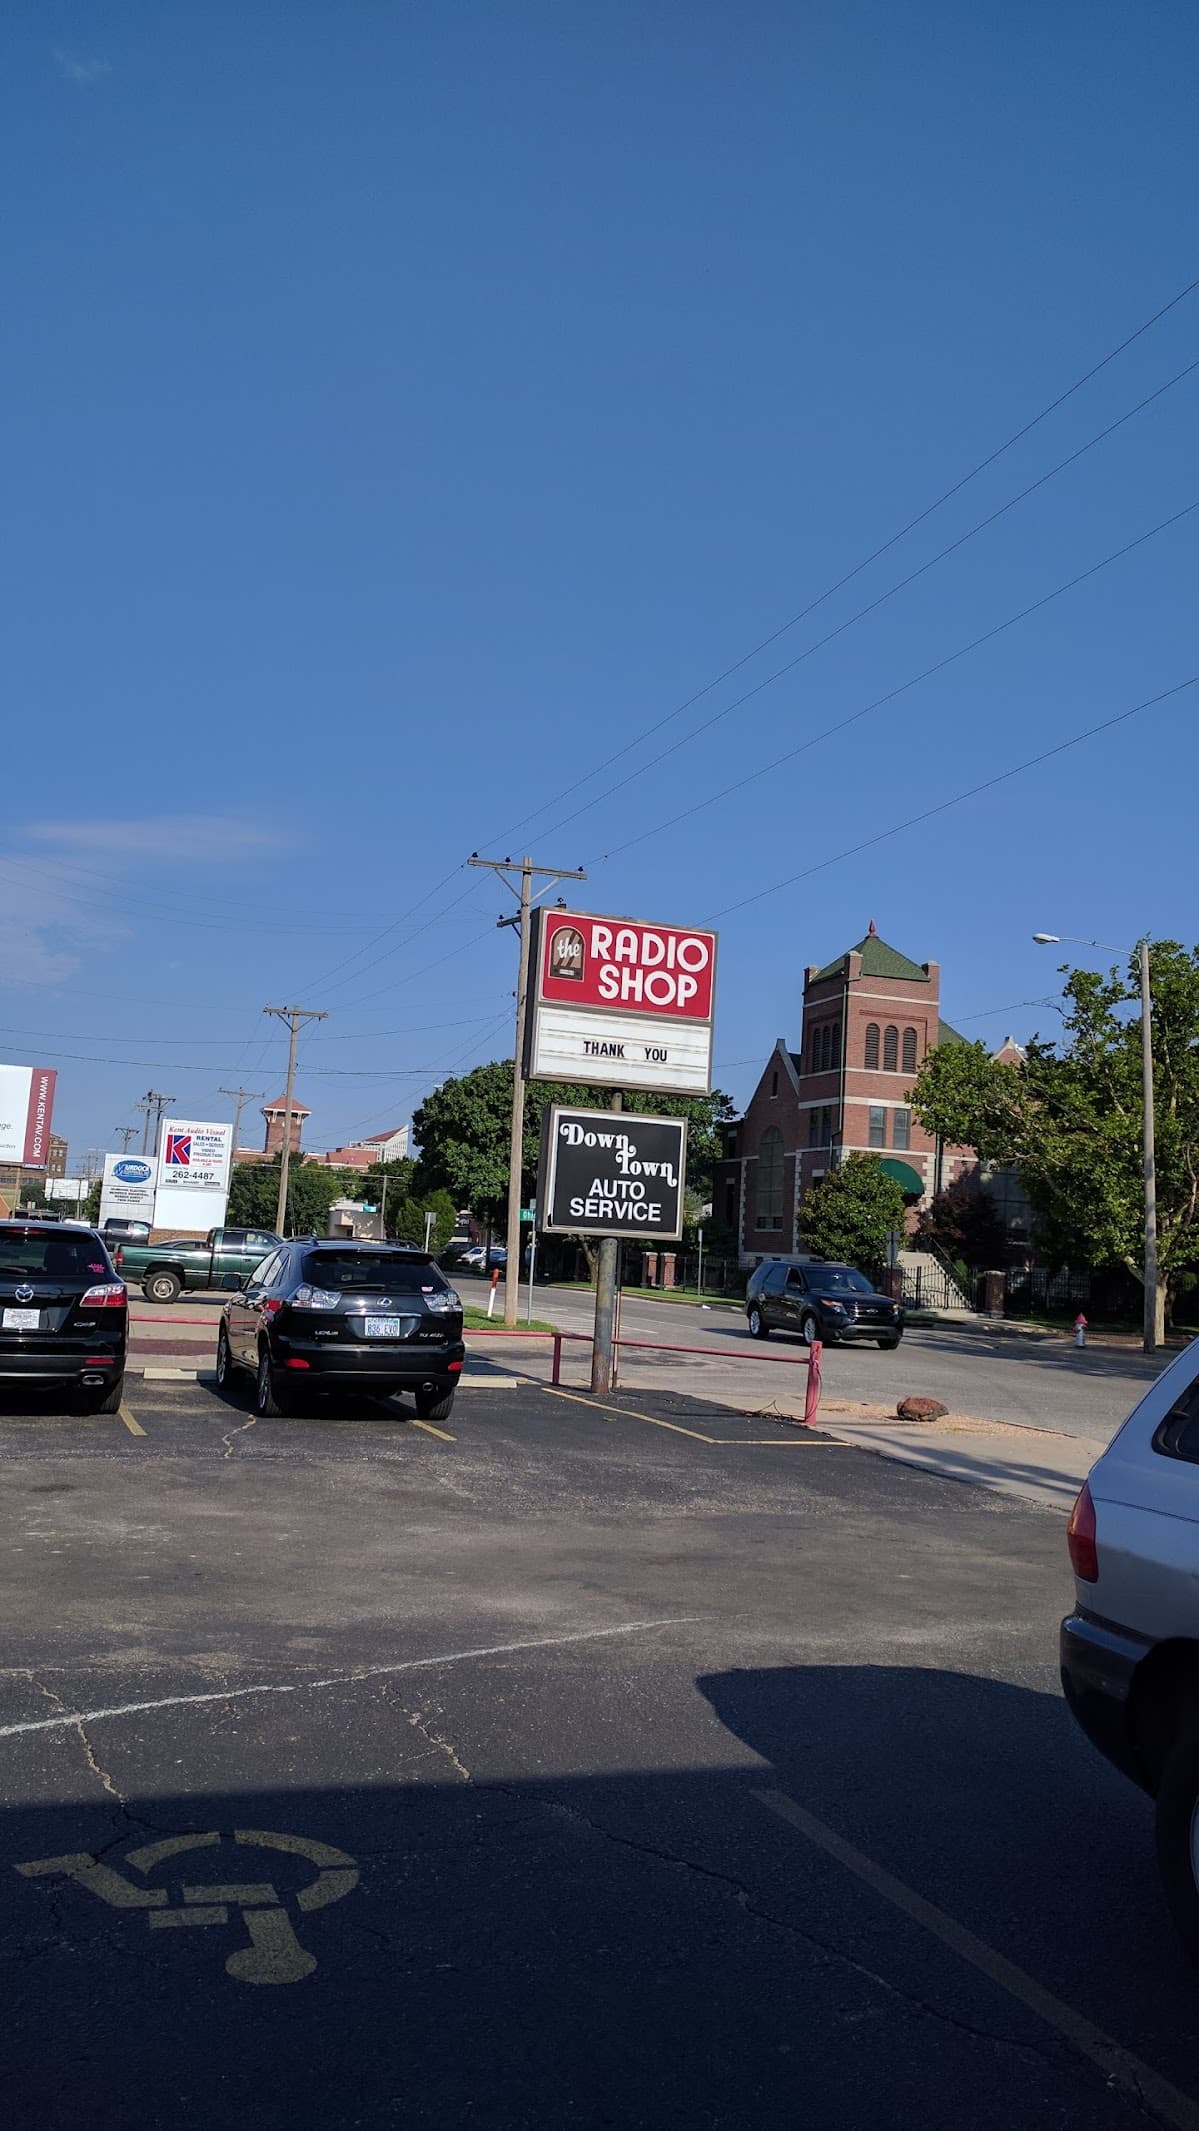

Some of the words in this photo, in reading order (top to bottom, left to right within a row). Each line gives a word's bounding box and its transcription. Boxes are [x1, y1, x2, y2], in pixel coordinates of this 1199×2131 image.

[557, 937, 580, 959] the
[590, 924, 709, 973] RADIO
[597, 963, 698, 1008] SHOP
[583, 1040, 625, 1058] THANK
[644, 1047, 668, 1062] YOU
[32, 1076, 49, 1158] WWW.KENTAV.COM
[559, 1123, 637, 1158] Down
[172, 1170, 214, 1180] 262-4487
[615, 1150, 678, 1187] Town
[588, 1178, 646, 1201] AUTO
[569, 1197, 662, 1222] SERVICE
